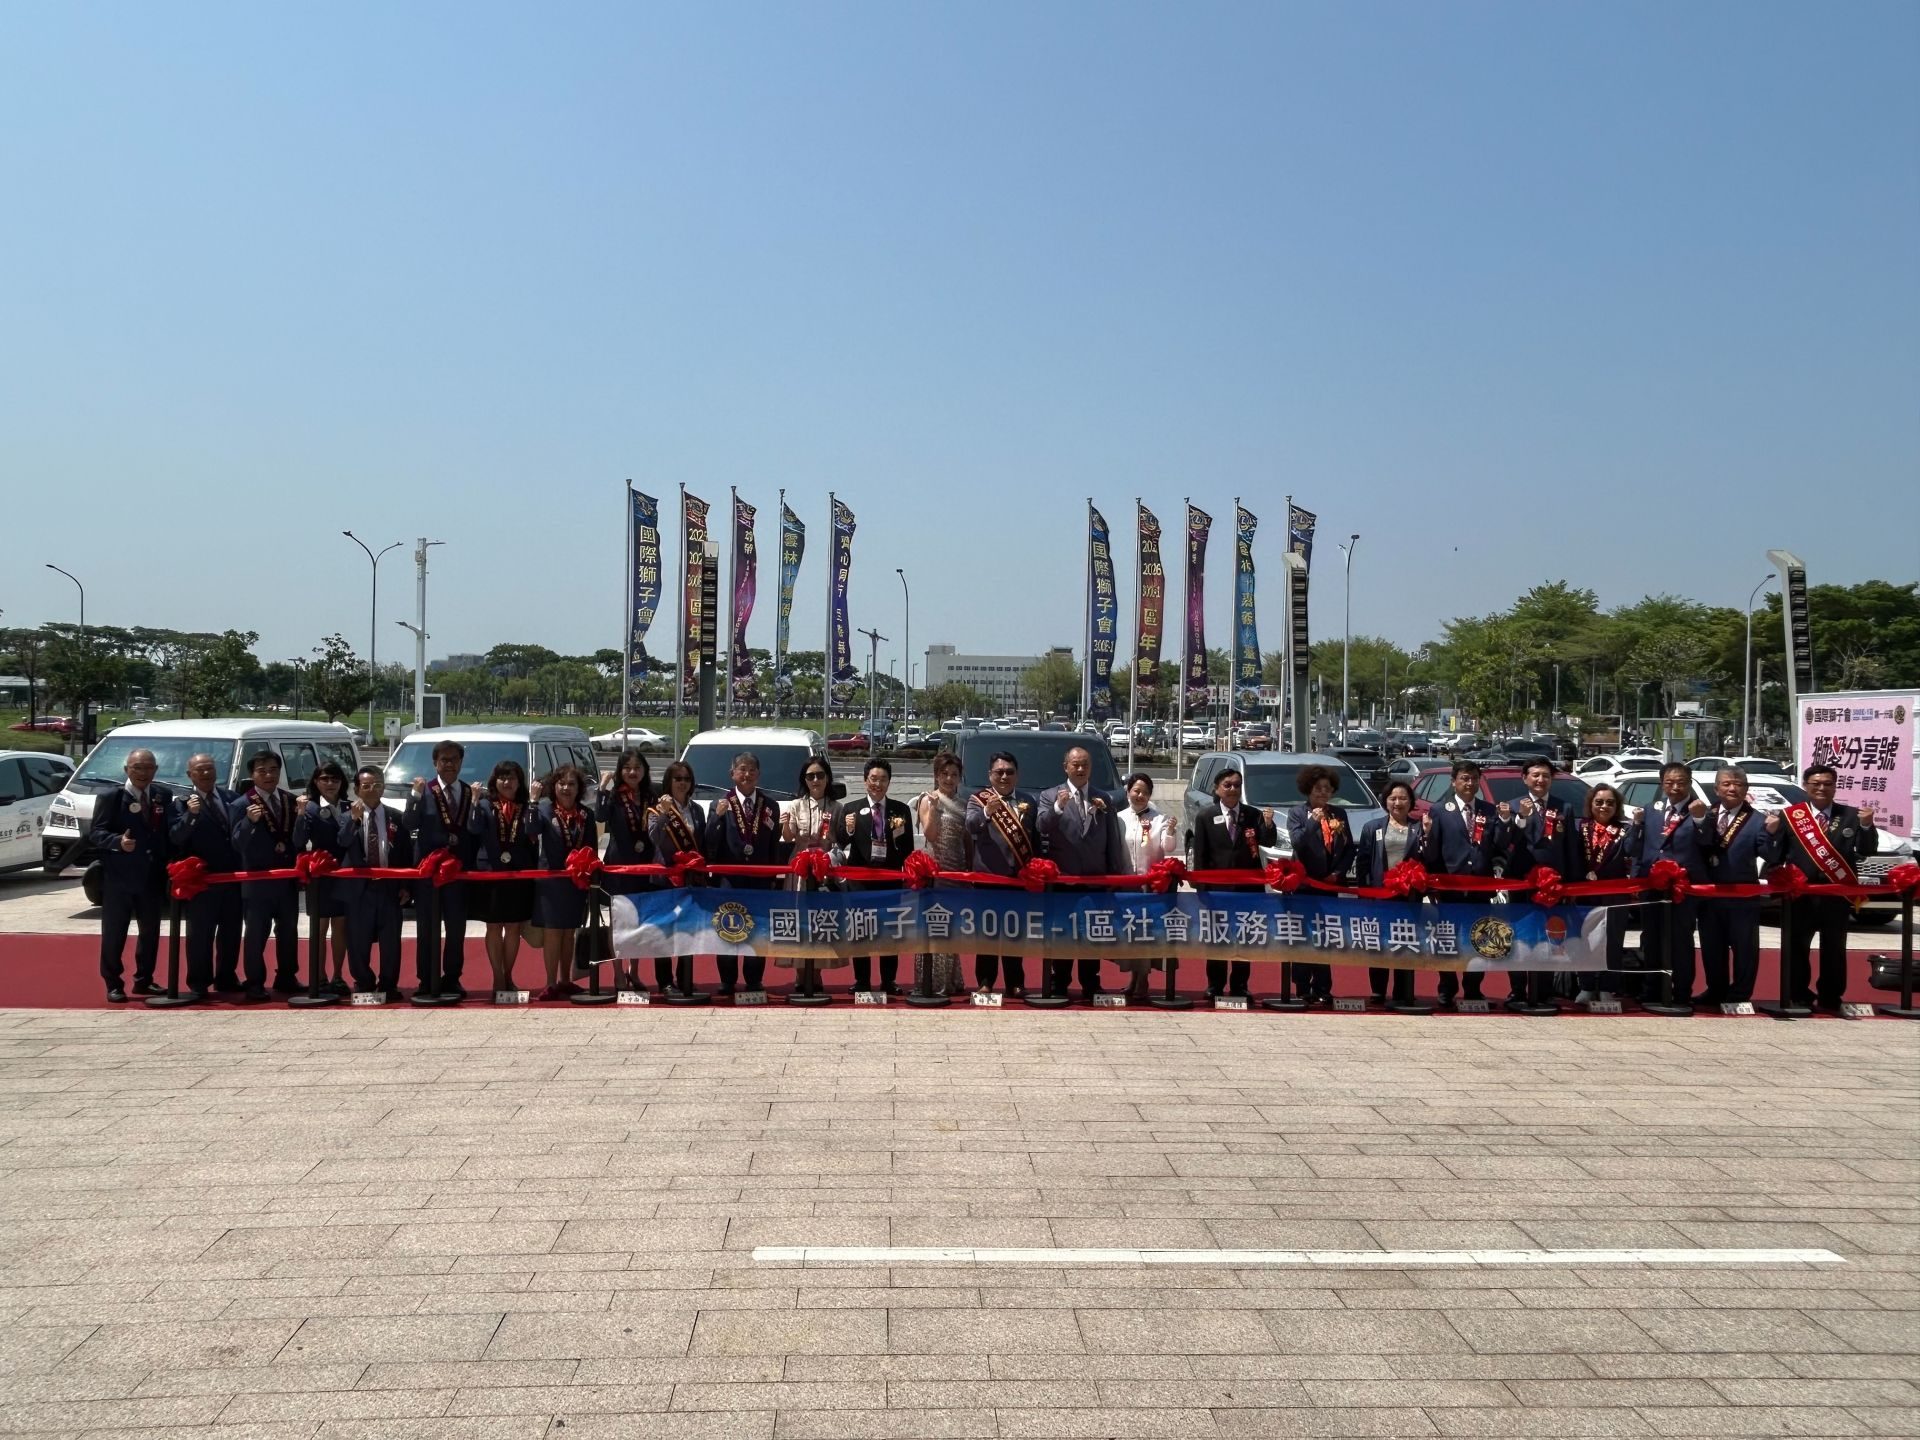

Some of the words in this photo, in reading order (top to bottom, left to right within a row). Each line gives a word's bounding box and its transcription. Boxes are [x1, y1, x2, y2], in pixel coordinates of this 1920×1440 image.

[1138, 608, 1158, 676] 區年會
[1814, 708, 1851, 723] 國際獅子會
[1811, 735, 1900, 771] 獅愛分享號
[768, 902, 1459, 956] 國際獅子會300E-1區社會服務車捐贈典禮
